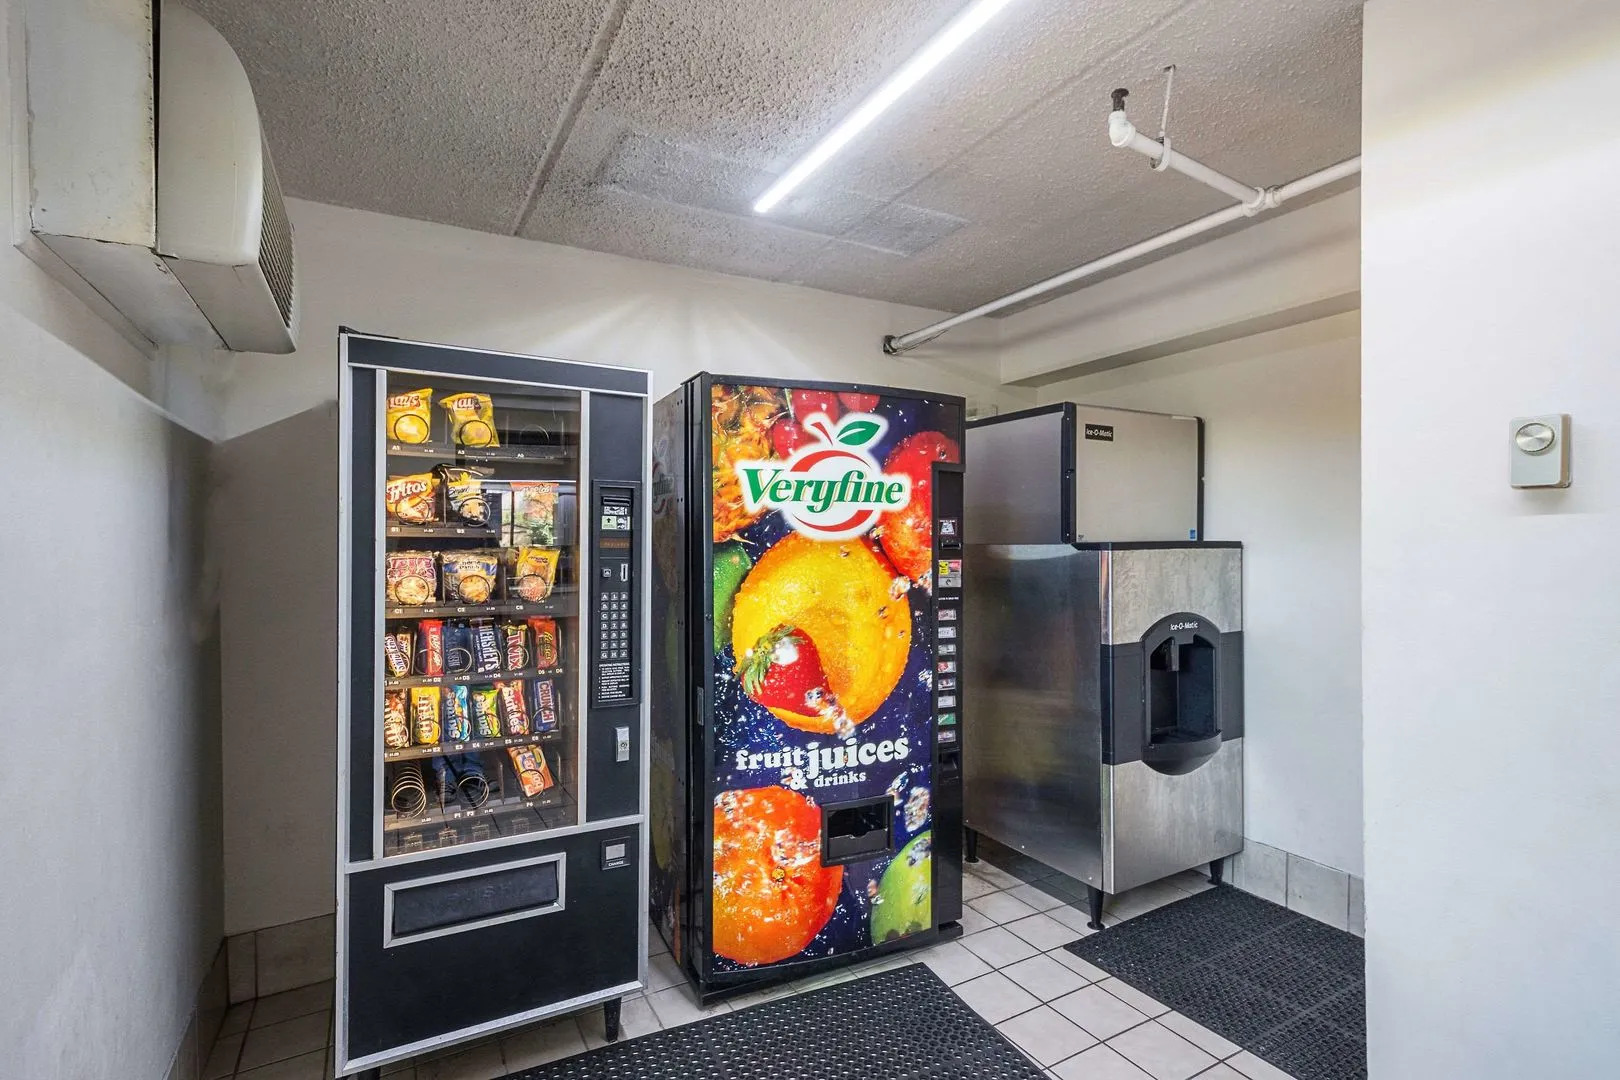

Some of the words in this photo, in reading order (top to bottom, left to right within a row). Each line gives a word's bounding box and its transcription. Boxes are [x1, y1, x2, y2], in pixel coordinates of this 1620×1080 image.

[1086, 428, 1113, 438] Ice-O-Matic
[742, 468, 903, 514] Veryfine
[1170, 621, 1199, 631] Ice-O-Matic
[539, 682, 555, 721] CRUNCH
[735, 746, 805, 770] fruit
[804, 737, 909, 779] juices
[789, 768, 809, 790] &
[813, 772, 867, 788] drinks
